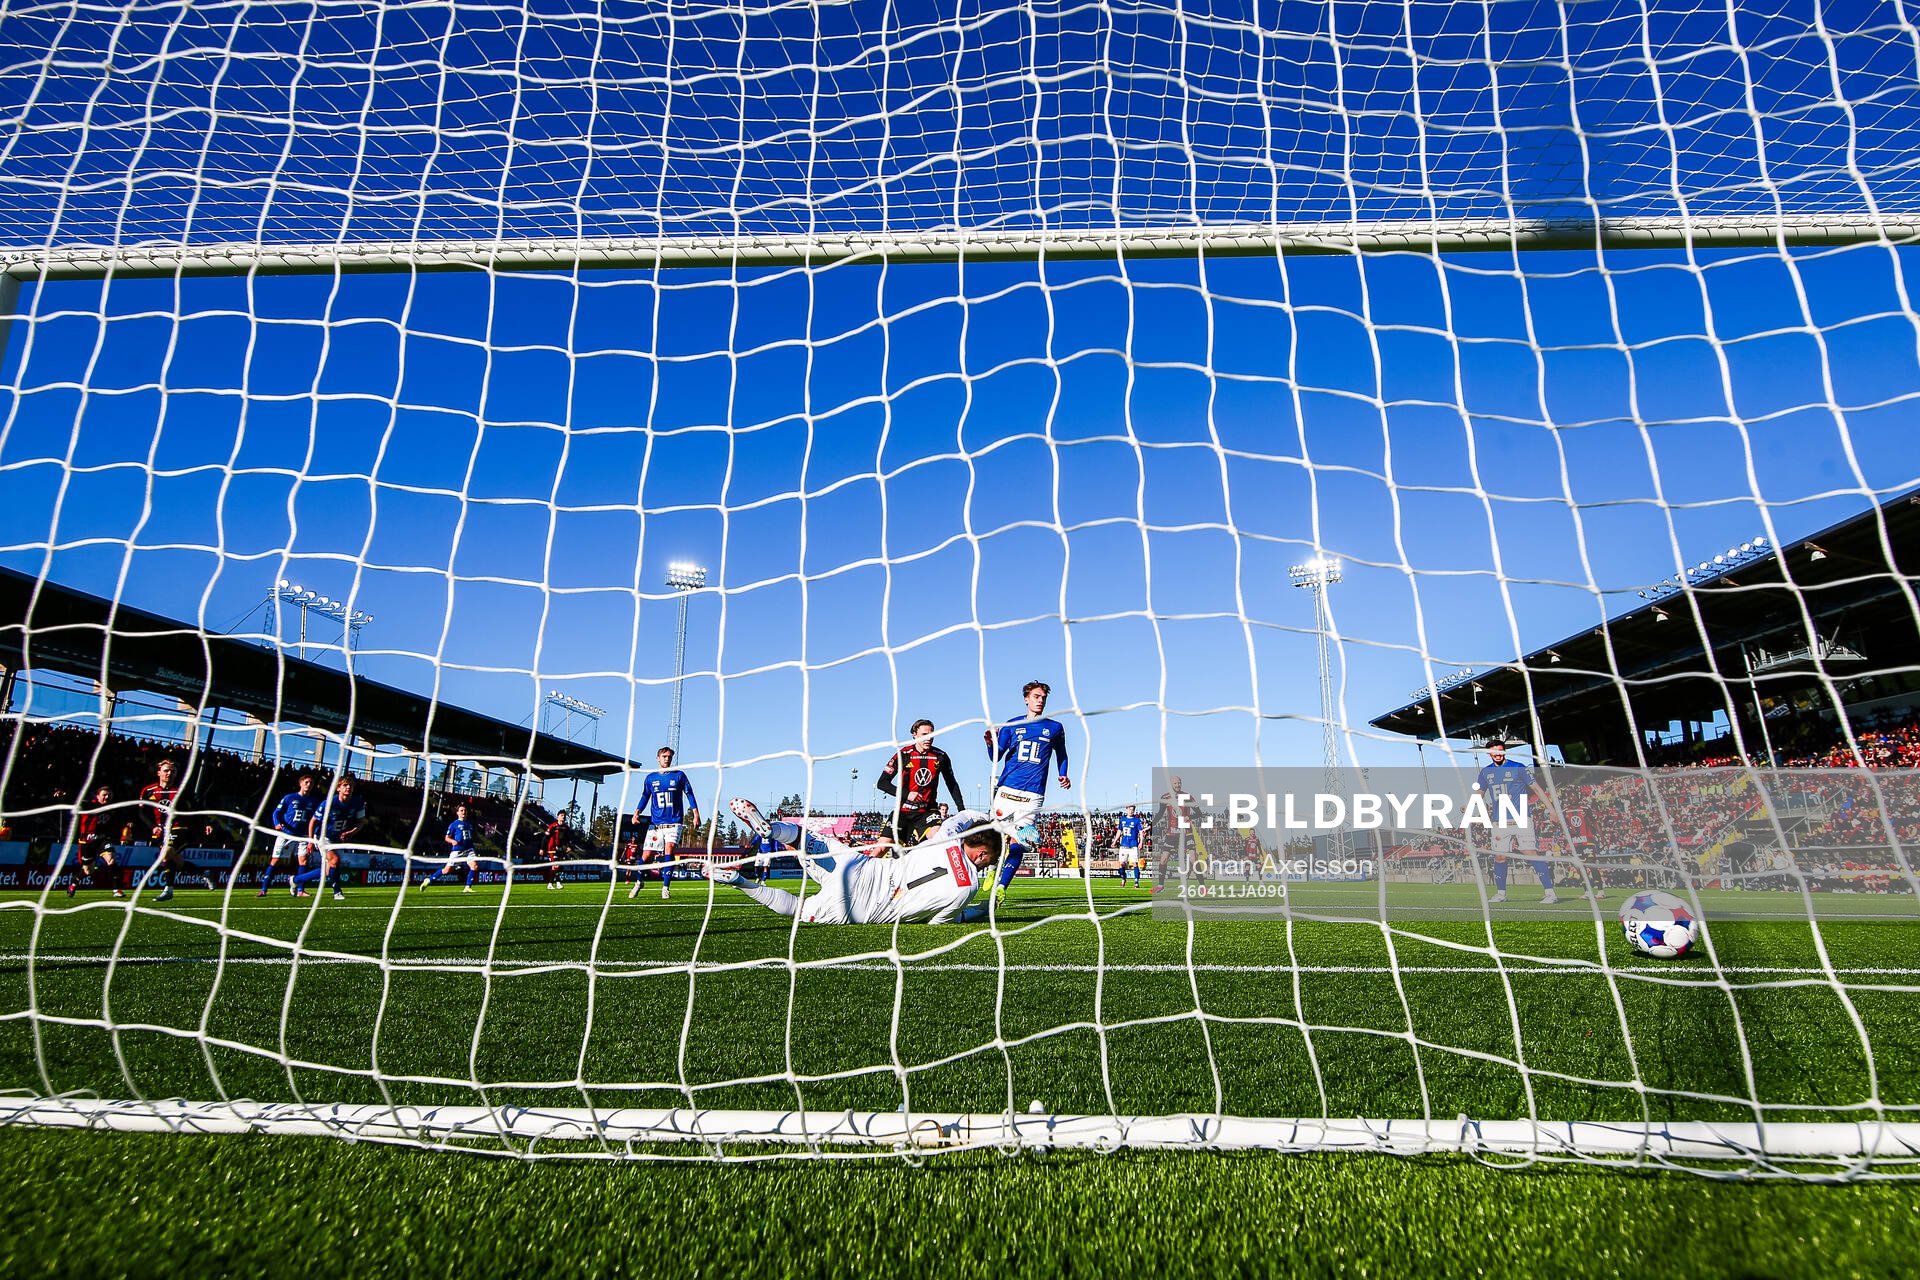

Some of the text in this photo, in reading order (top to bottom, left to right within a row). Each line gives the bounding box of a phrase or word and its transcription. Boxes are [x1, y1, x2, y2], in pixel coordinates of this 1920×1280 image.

[1017, 740, 1041, 764] EL
[657, 791, 673, 808] EL
[951, 850, 967, 882] elcenter
[27, 870, 94, 889] Kompetns.
[174, 871, 210, 887] Kunska
[907, 867, 948, 890] 1
[1628, 916, 1642, 950] SELECT
